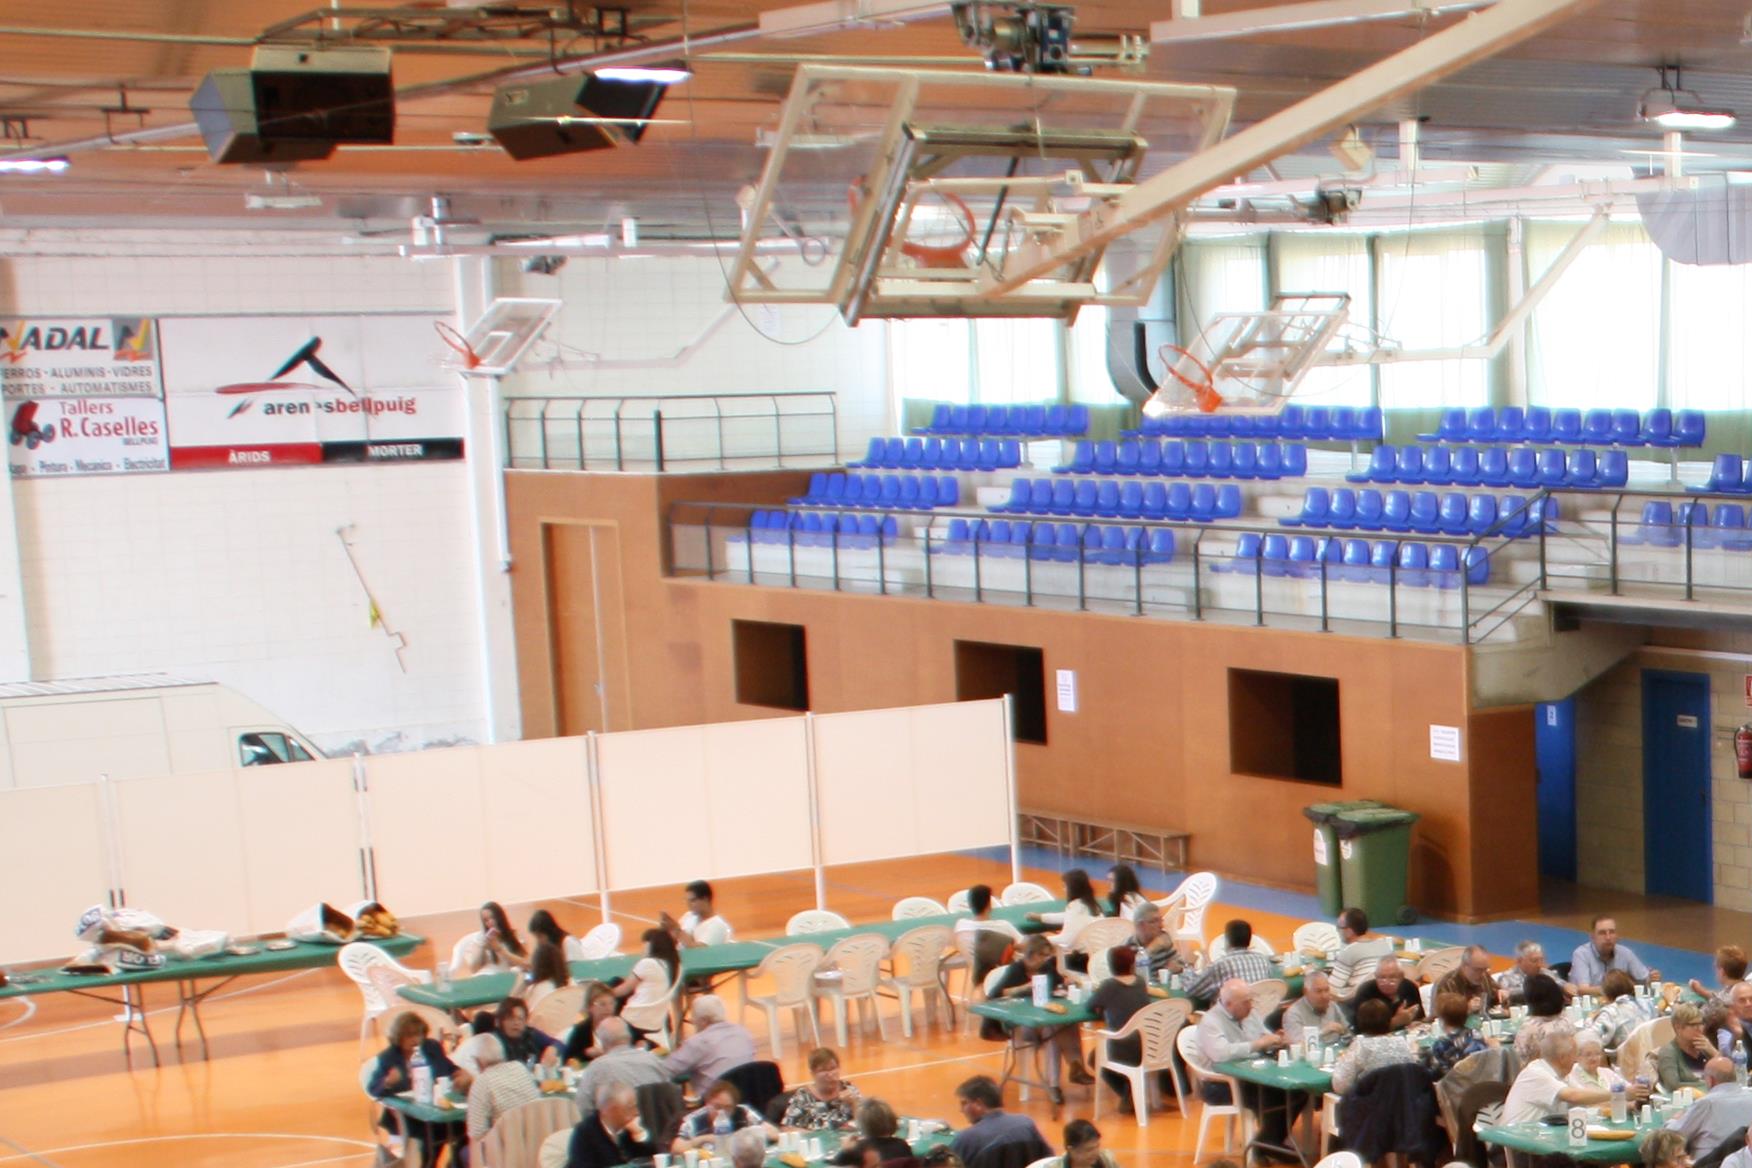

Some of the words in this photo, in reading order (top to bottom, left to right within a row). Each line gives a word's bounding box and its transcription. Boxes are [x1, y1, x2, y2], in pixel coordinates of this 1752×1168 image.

[51, 366, 106, 378] ALUMINIS
[113, 365, 152, 377] VIDRES
[61, 381, 152, 394] AUTOMATISMES
[60, 400, 113, 415] Tallers
[228, 448, 271, 464] ÀRIDS
[367, 443, 423, 458] MORTER
[1571, 1118, 1585, 1139] 8
